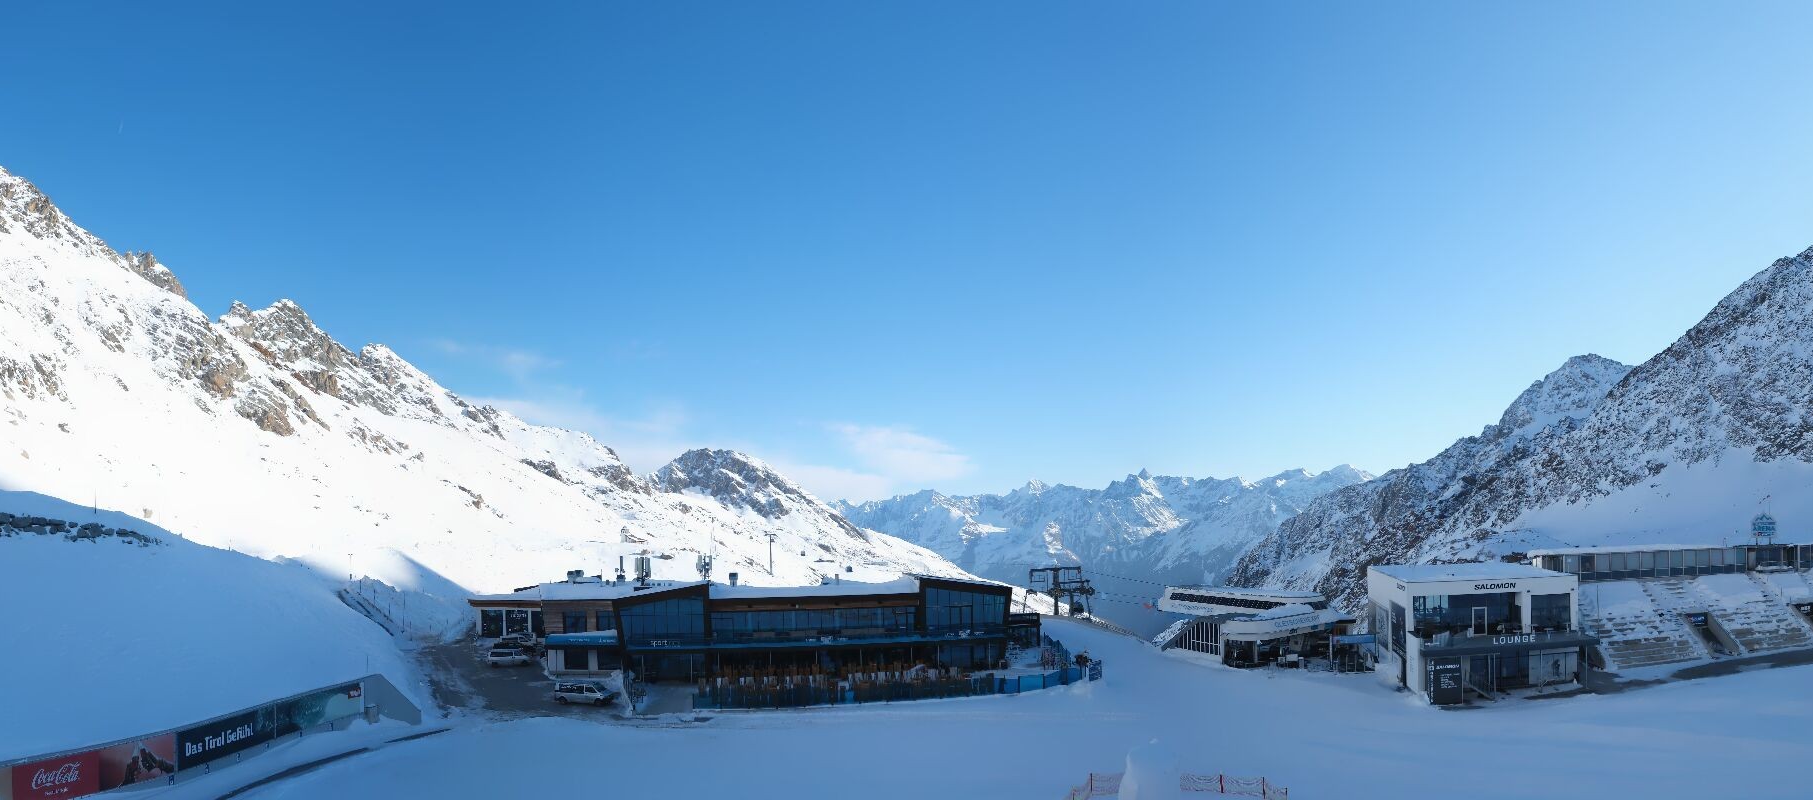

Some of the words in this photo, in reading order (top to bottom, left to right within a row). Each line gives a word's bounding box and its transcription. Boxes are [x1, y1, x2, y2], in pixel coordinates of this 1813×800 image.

[1474, 582, 1517, 591] SALOMON
[1493, 634, 1537, 645] LOUNGE
[185, 742, 203, 757] Das
[204, 731, 225, 751] Tirol
[226, 722, 254, 744] Gefühl
